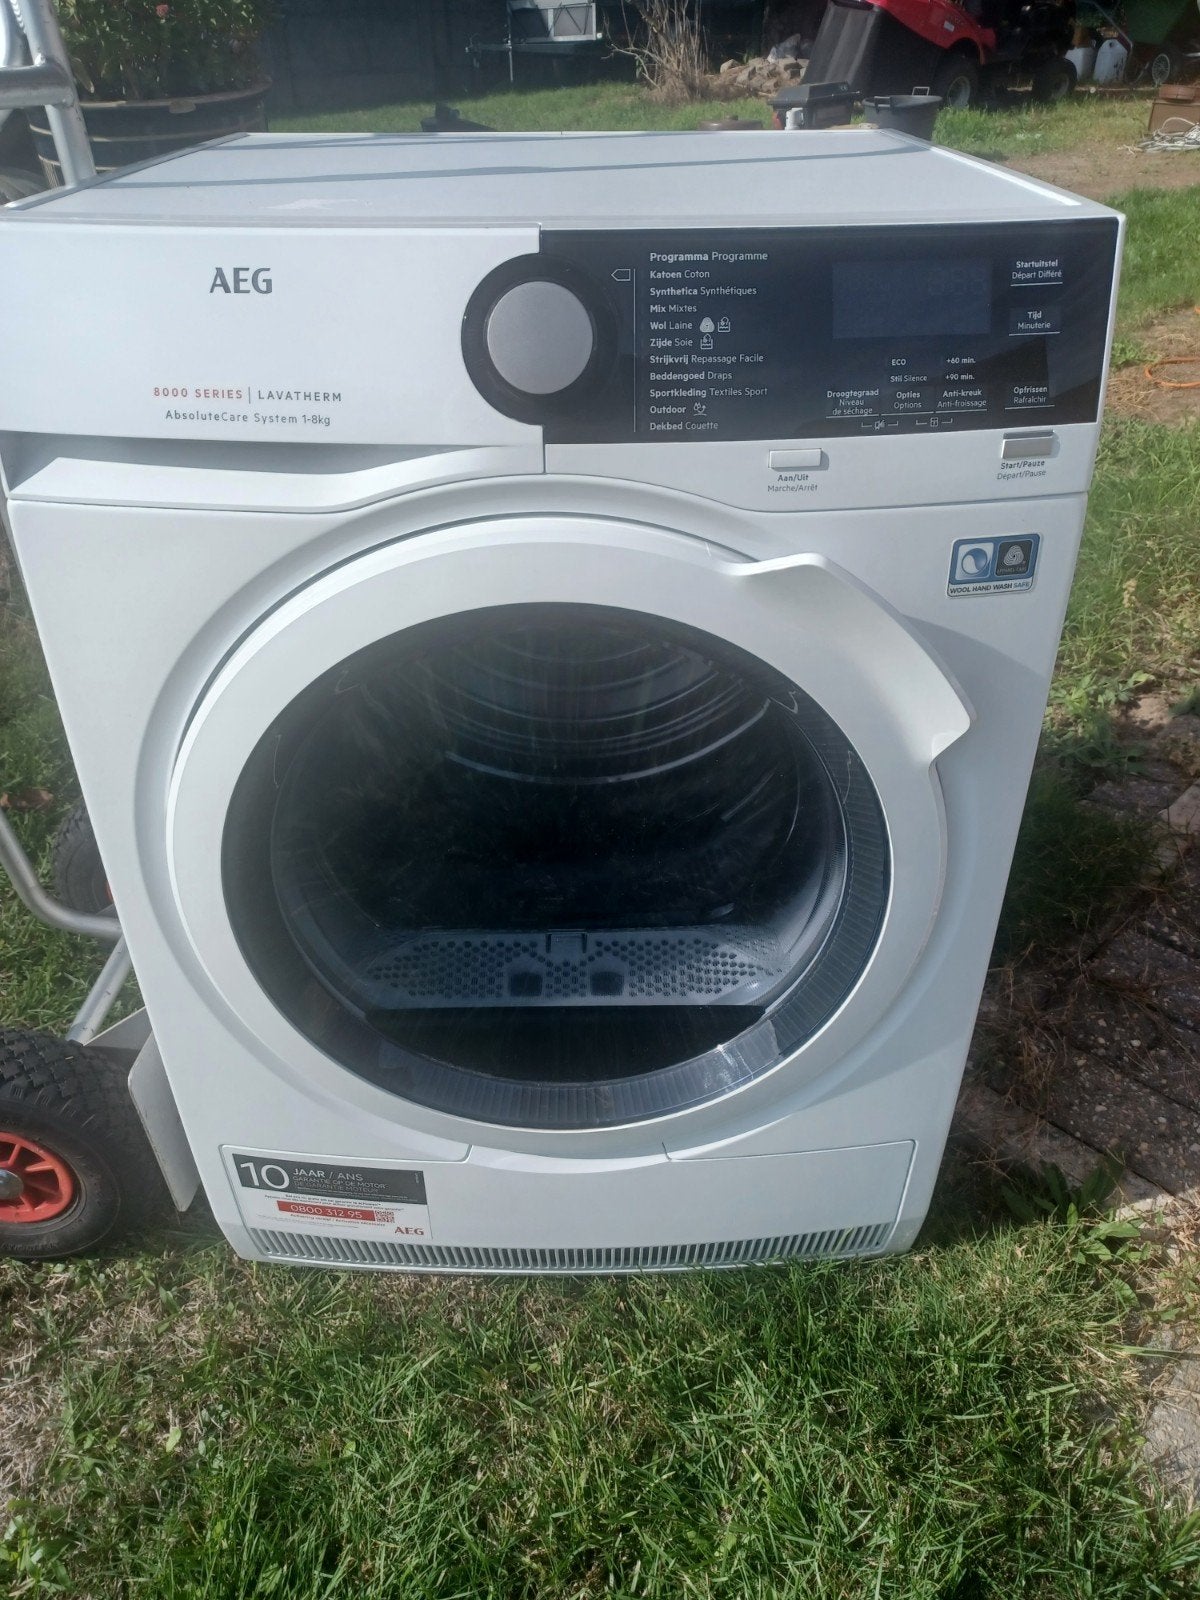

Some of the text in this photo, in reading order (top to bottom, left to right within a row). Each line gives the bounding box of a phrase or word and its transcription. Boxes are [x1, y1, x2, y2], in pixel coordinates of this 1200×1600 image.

[650, 252, 768, 263] Programma Programme
[1016, 259, 1058, 268] Startuitstel
[650, 270, 710, 279] Katoen Coton
[1012, 270, 1036, 280] Départ
[210, 267, 273, 294] AEG
[650, 286, 757, 297] Synthetica Synthétiques
[650, 304, 697, 313] Mix Mixtes
[1028, 311, 1042, 321] Tijd
[669, 321, 693, 329] Laine
[1018, 321, 1051, 329] Minuterie
[650, 338, 693, 347] Zijde Soie
[650, 354, 764, 365] Strijkvrij Repassage Facile
[650, 372, 732, 381] Beddengoed Draps
[904, 374, 927, 382] Silence
[153, 387, 342, 402] 8000 SERIES LAVATHERM
[650, 387, 767, 398] Sportkleding Textiles Sport
[827, 389, 879, 398] Droogtegraad
[943, 389, 982, 397] Anti-kreuk
[1013, 386, 1047, 395] Opfrissen
[896, 391, 920, 400] Opties
[894, 400, 922, 409] Options
[937, 399, 987, 408] Anti-froissage
[650, 406, 686, 414] Outdoor
[832, 406, 873, 415] de séchage
[166, 410, 331, 426] AbsoluteCare System 1-8kg
[650, 422, 718, 430] Dekbed Couette
[1000, 460, 1045, 470] Start/Pauze
[768, 483, 818, 492] Marche/Arrêt
[240, 1162, 290, 1189] 10
[293, 1168, 325, 1178] JAAR
[337, 1172, 364, 1182] ANS
[290, 1204, 363, 1218] 0800 312 95
[395, 1226, 424, 1236] AEG
